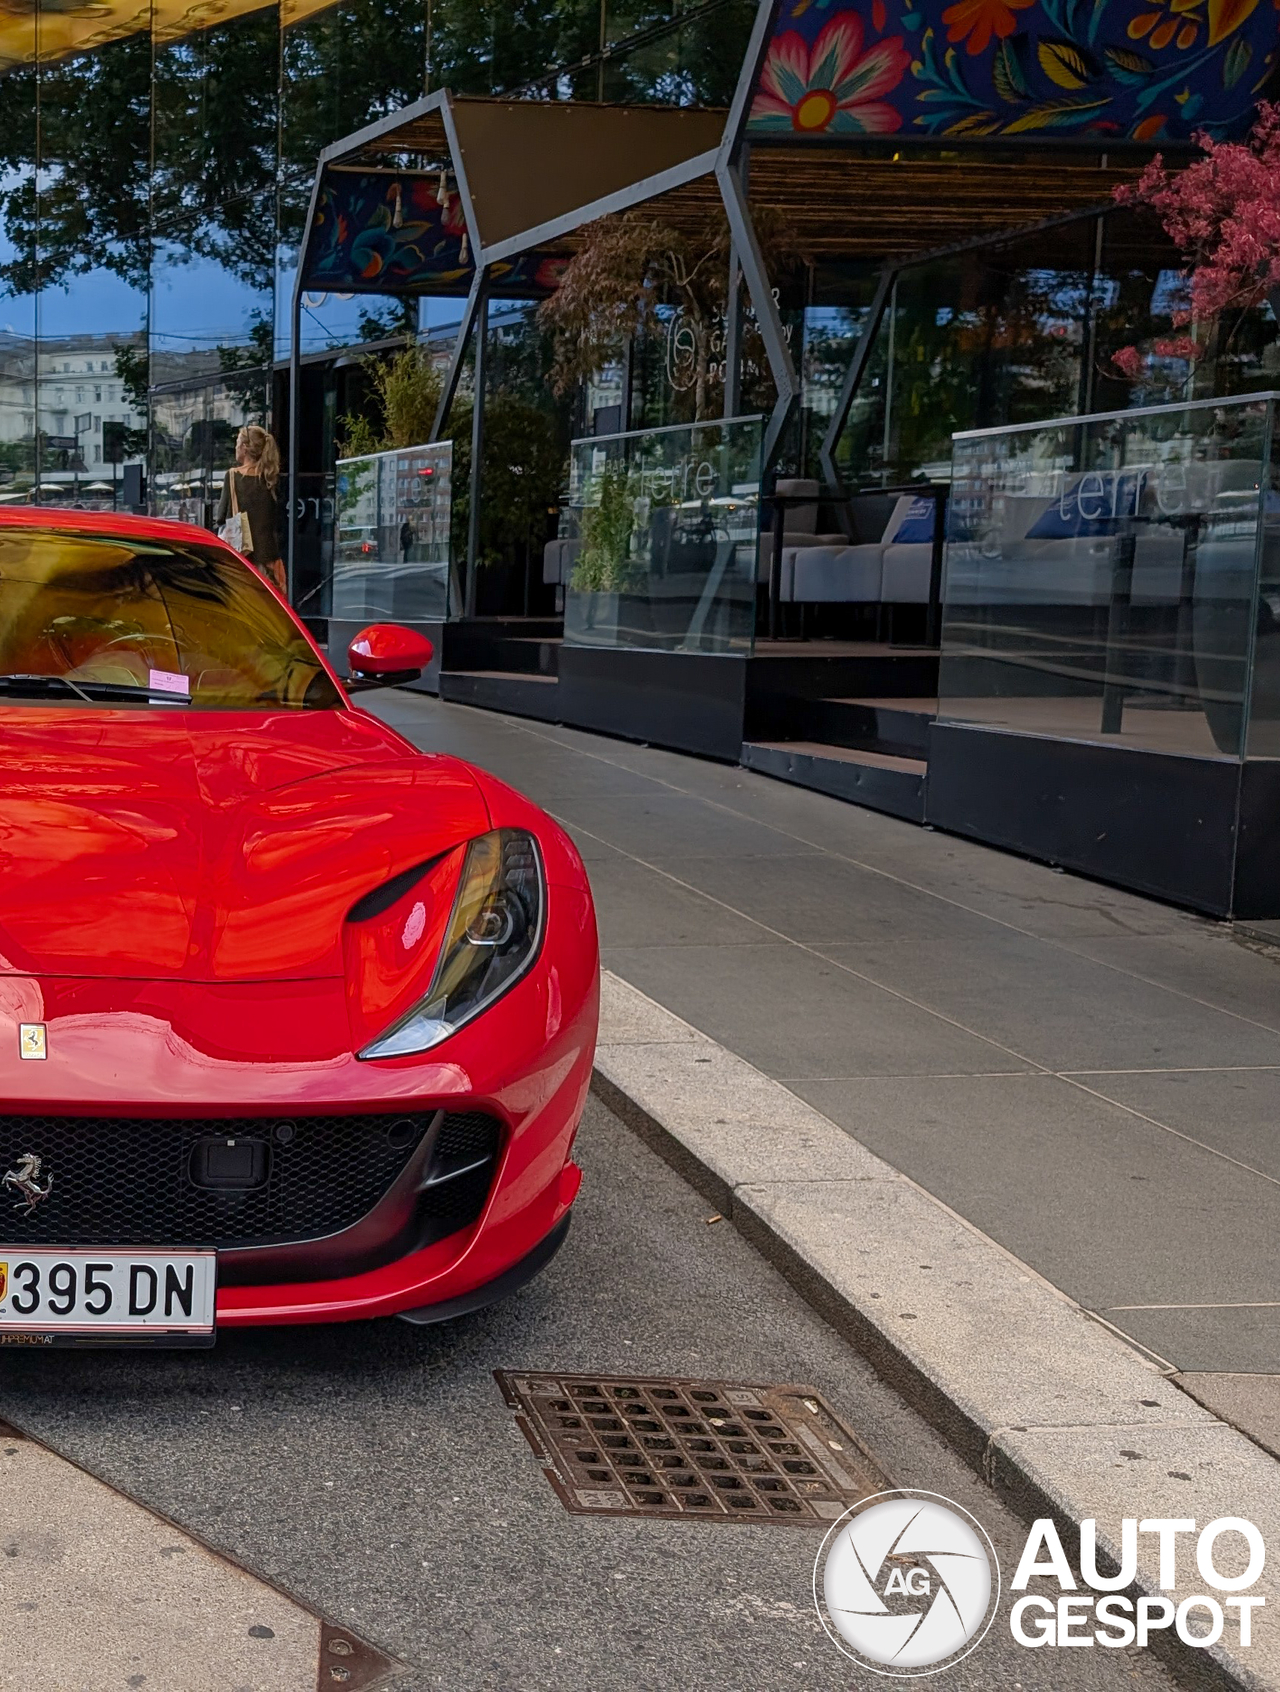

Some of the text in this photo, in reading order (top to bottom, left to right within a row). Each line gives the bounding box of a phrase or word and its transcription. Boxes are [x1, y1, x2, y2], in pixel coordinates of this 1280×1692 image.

[1058, 456, 1187, 520] terre
[11, 1261, 114, 1316] 395
[128, 1262, 195, 1317] DN
